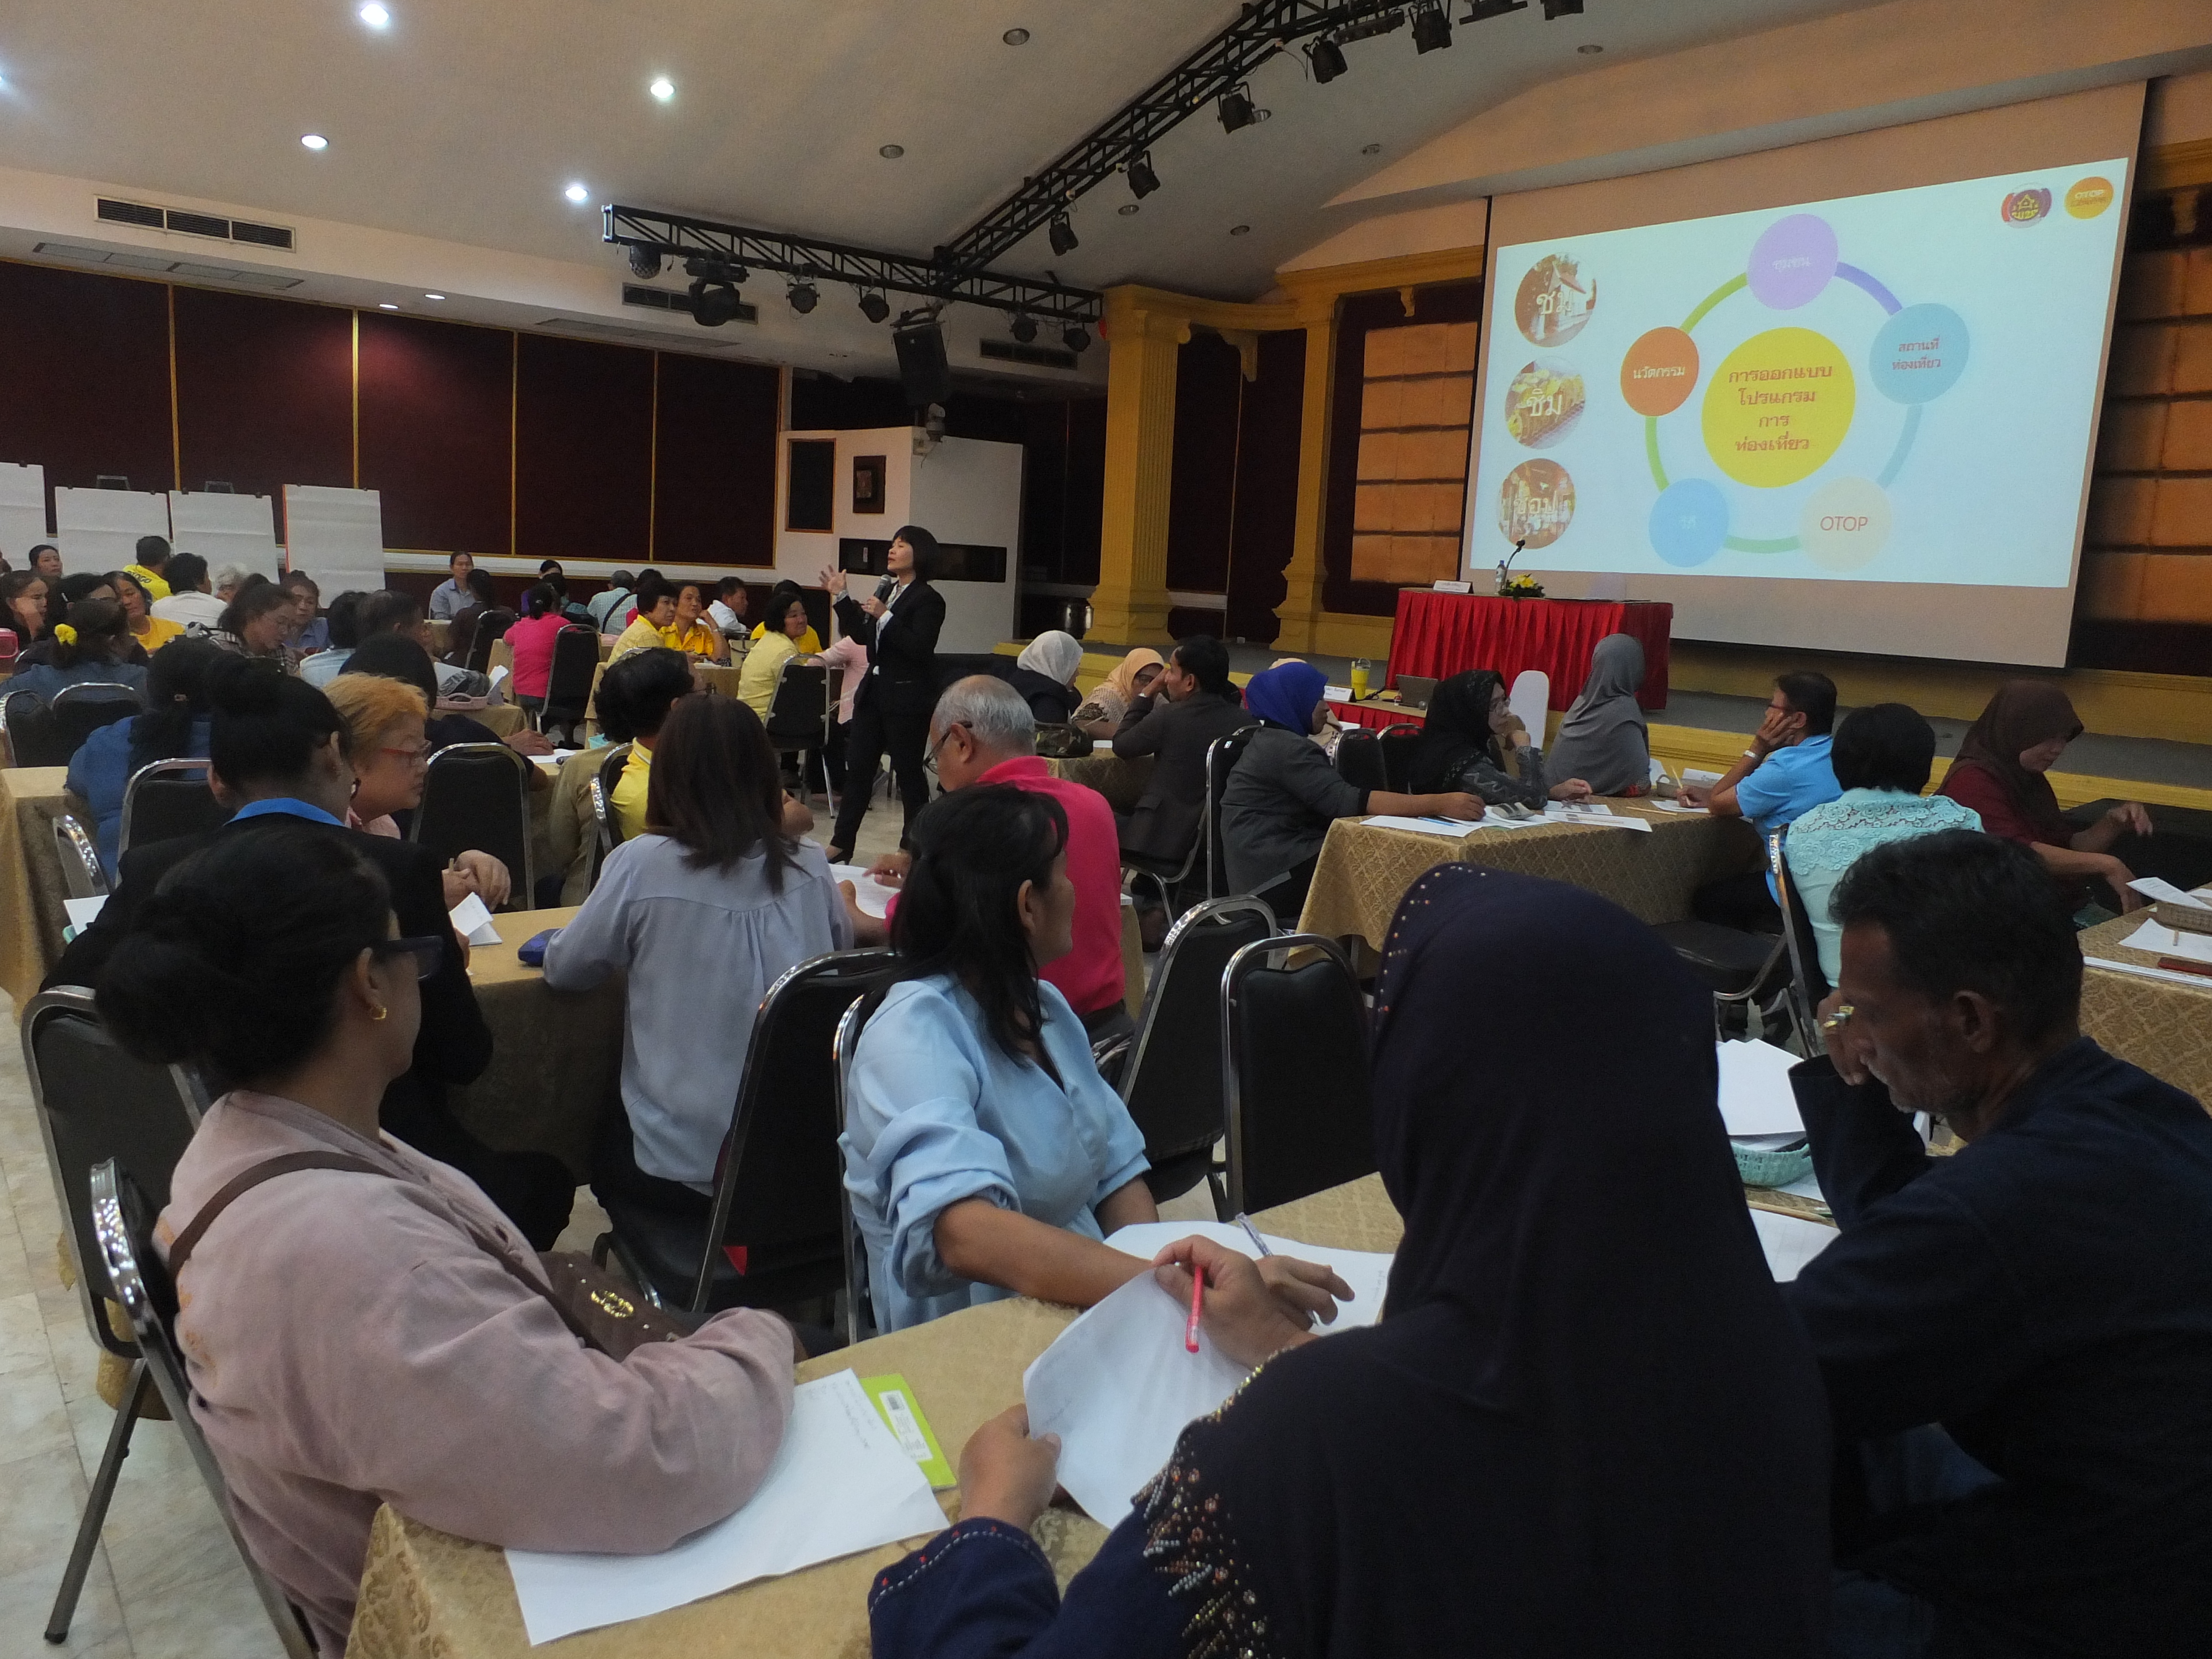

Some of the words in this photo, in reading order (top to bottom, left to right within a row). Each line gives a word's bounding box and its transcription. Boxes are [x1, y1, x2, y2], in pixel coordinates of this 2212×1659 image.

[1898, 336, 1940, 352] สถานที่
[1892, 354, 1942, 370] ท่องเที่ยว
[1633, 366, 1686, 379] นวัตกรรม
[1729, 366, 1833, 383] การออกแบบ
[1526, 388, 1563, 417] ชิม
[1738, 388, 1816, 406] โปรแกรม
[1759, 415, 1790, 428] การ
[1735, 431, 1810, 452] ท่องเที่ยว
[1820, 516, 1869, 531] OTOP
